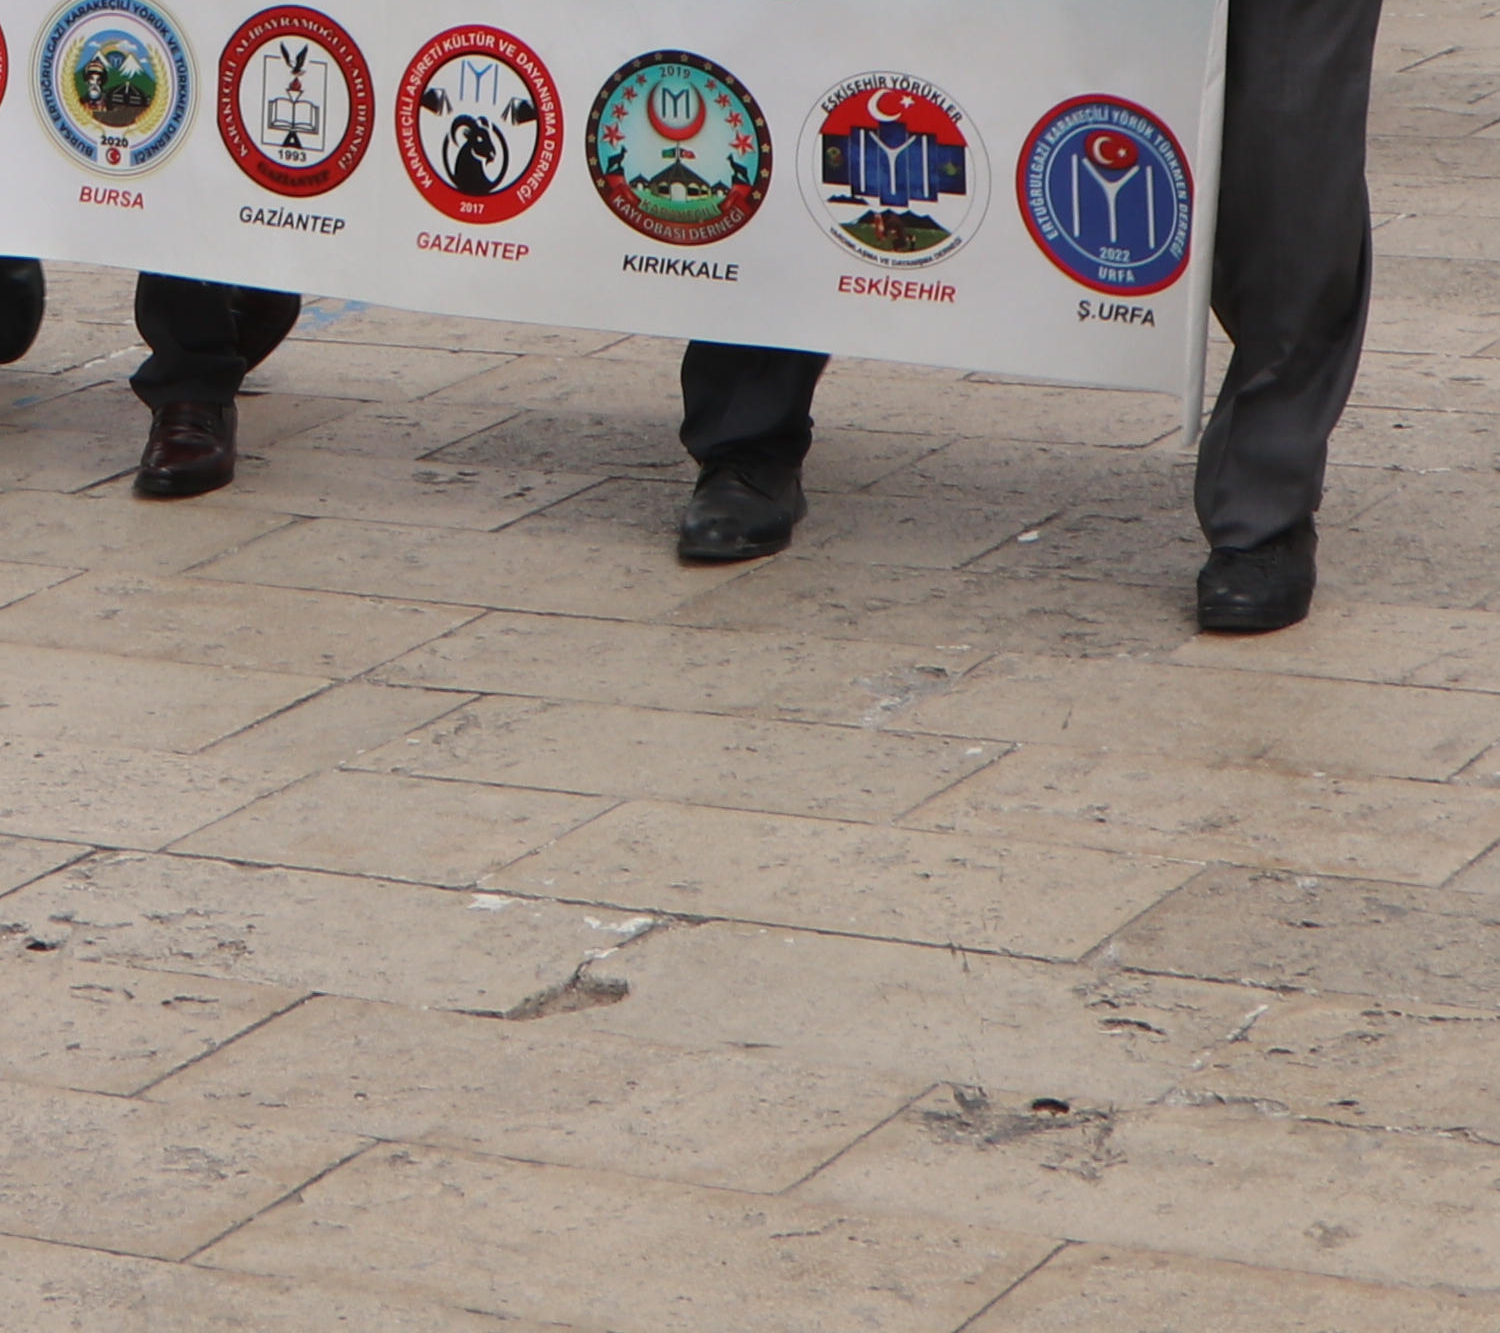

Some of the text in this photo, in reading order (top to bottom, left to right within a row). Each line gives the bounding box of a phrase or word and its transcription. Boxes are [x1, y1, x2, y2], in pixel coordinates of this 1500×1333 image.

[167, 35, 181, 56] VE
[659, 66, 691, 79] 2019
[401, 31, 557, 204] KARAKEÇİLİ AŞİRETİ KÜLTÜR VE DAYANIŞMA DERNEĞİ
[101, 134, 129, 148] 2020
[277, 149, 307, 163] 1993
[79, 185, 145, 210] BURSA
[459, 201, 485, 215] 2017
[239, 205, 346, 235] GAZİANTEP
[613, 195, 745, 241] KAYI OBASI DERNEĞİ
[416, 231, 530, 261] GAZİANTEP
[1099, 247, 1131, 263] 2022
[622, 254, 740, 282] KIRIKKALE
[1098, 266, 1136, 283] URFA
[838, 275, 957, 304] ESKİŞEHİR
[1077, 299, 1156, 327] Ş.URFA
